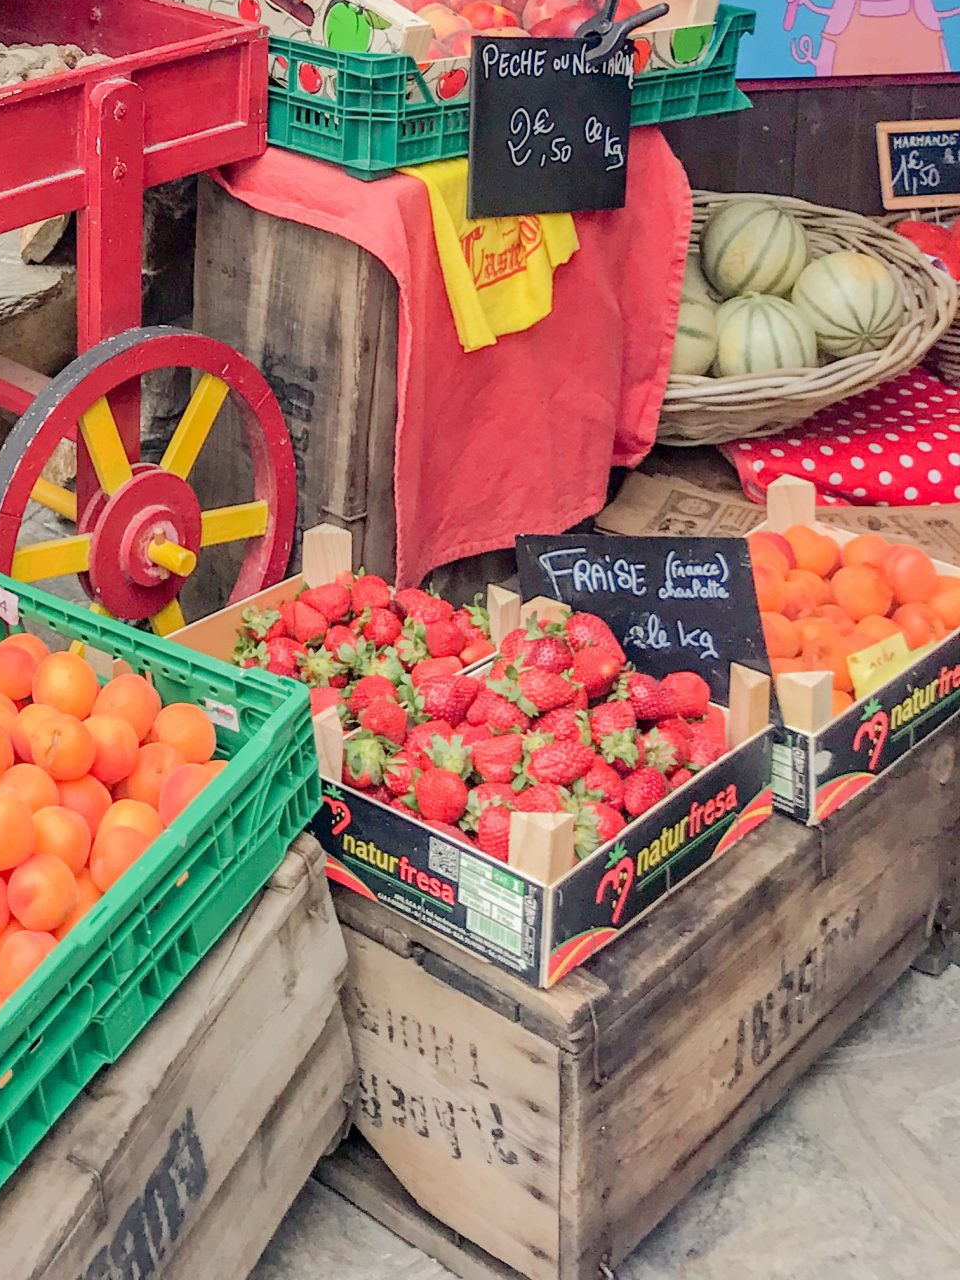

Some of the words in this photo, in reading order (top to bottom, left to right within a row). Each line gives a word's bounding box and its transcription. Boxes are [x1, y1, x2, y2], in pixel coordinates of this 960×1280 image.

[483, 44, 546, 78] PECHE
[585, 117, 602, 143] le
[605, 127, 624, 171] kg
[539, 548, 646, 601] FRAISE
[677, 620, 719, 660] kg
[636, 784, 738, 876] naturfresa
[342, 832, 456, 906] naturfresa
